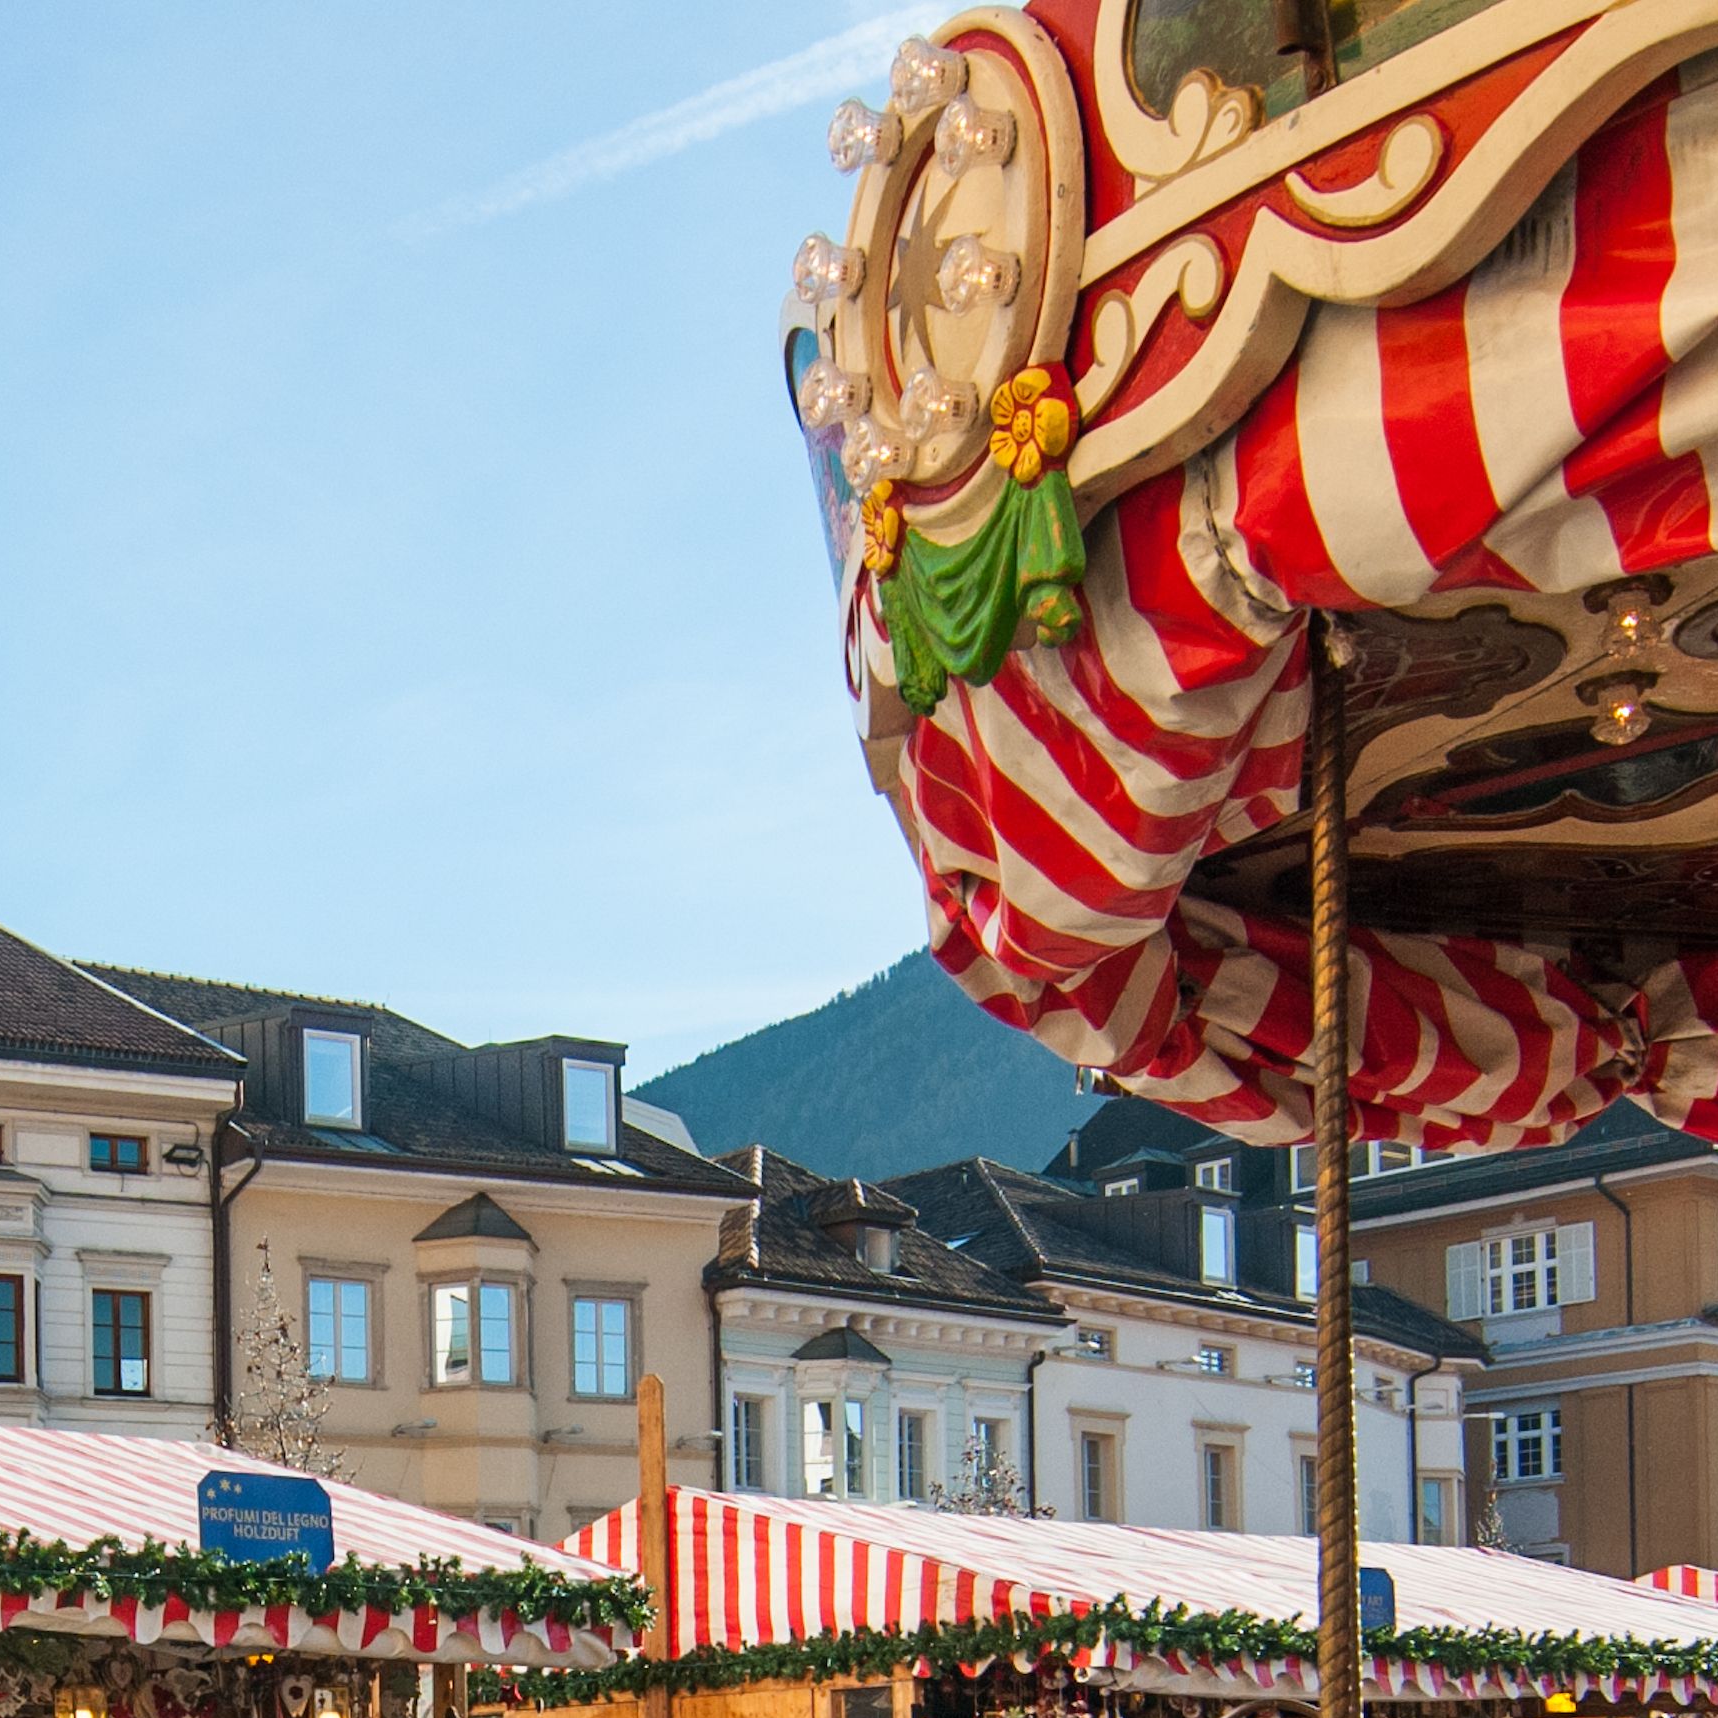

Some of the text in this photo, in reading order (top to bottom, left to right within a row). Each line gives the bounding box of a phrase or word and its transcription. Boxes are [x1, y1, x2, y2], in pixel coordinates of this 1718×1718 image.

[202, 1506, 329, 1529] PROFUMI DEL LEGNO
[233, 1524, 300, 1541] HOLZDUFT
